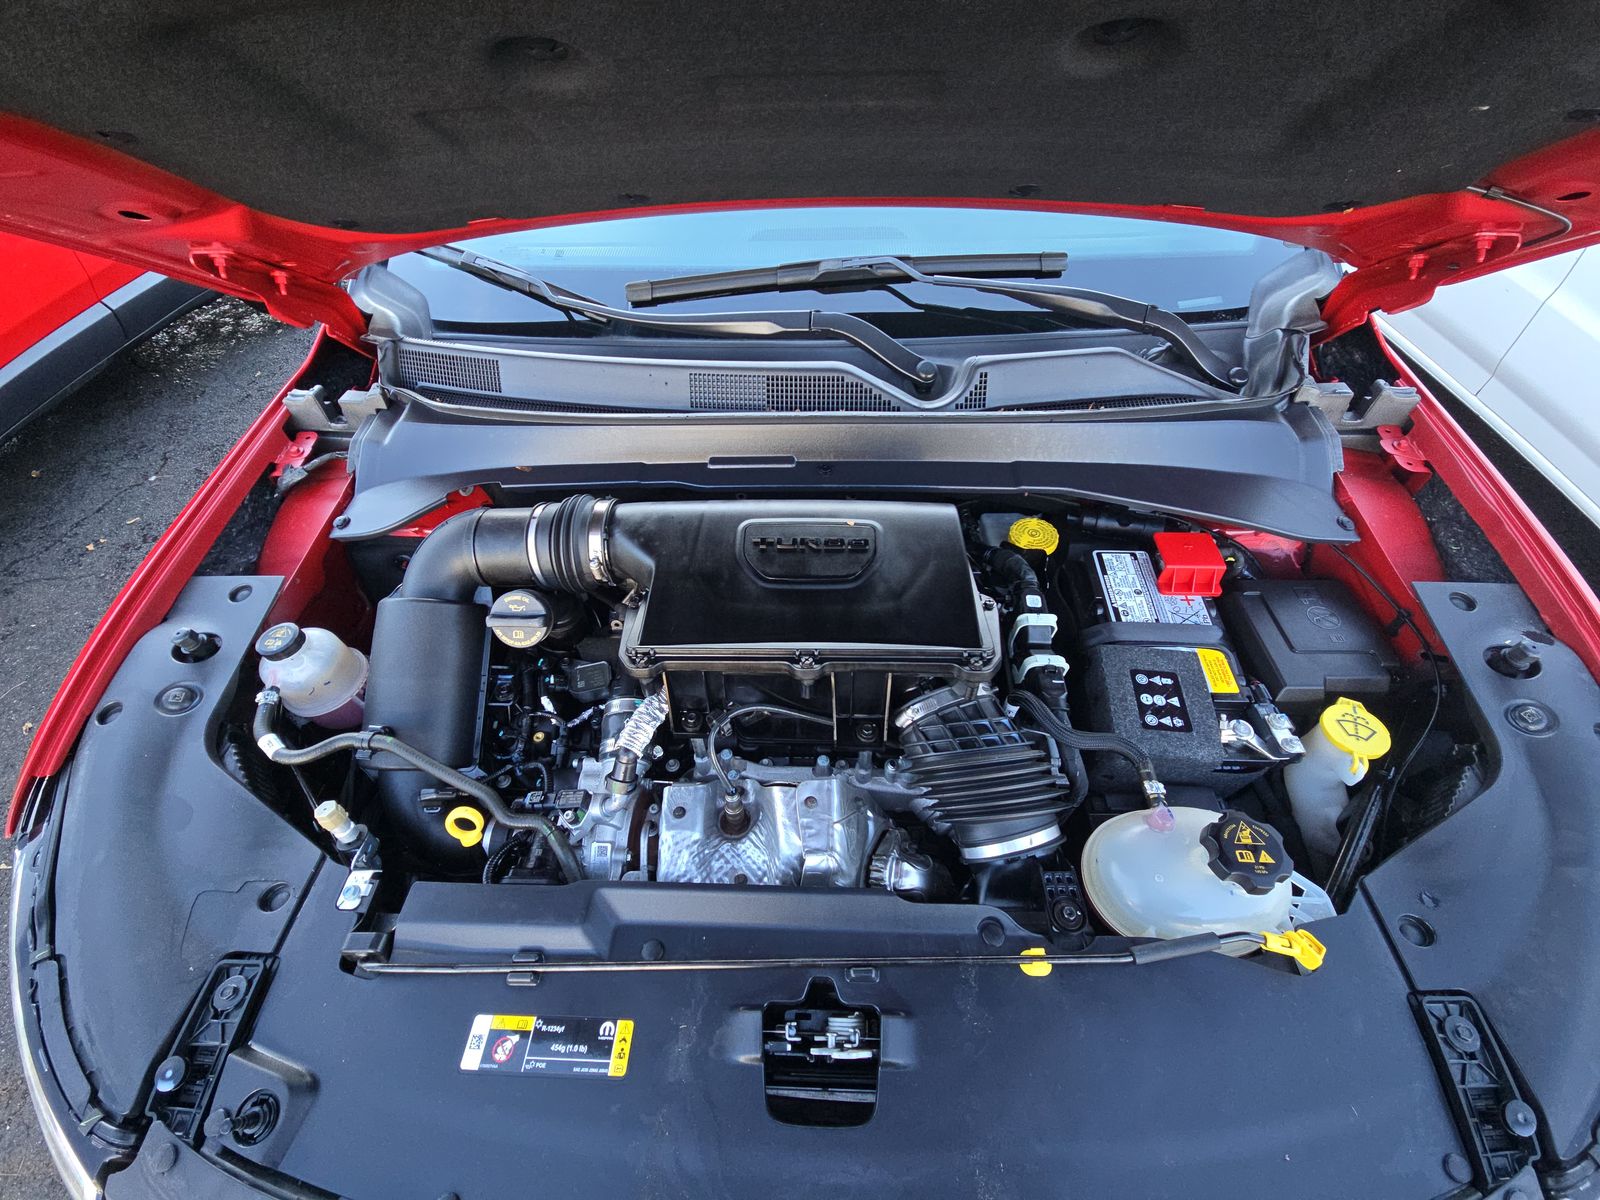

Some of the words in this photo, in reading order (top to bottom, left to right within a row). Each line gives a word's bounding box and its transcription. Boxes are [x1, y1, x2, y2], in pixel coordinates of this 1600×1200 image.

[752, 537, 869, 551] TURBO
[551, 1043, 566, 1054] 454g
[566, 1044, 579, 1054] (1.0
[579, 1044, 588, 1055] lb)
